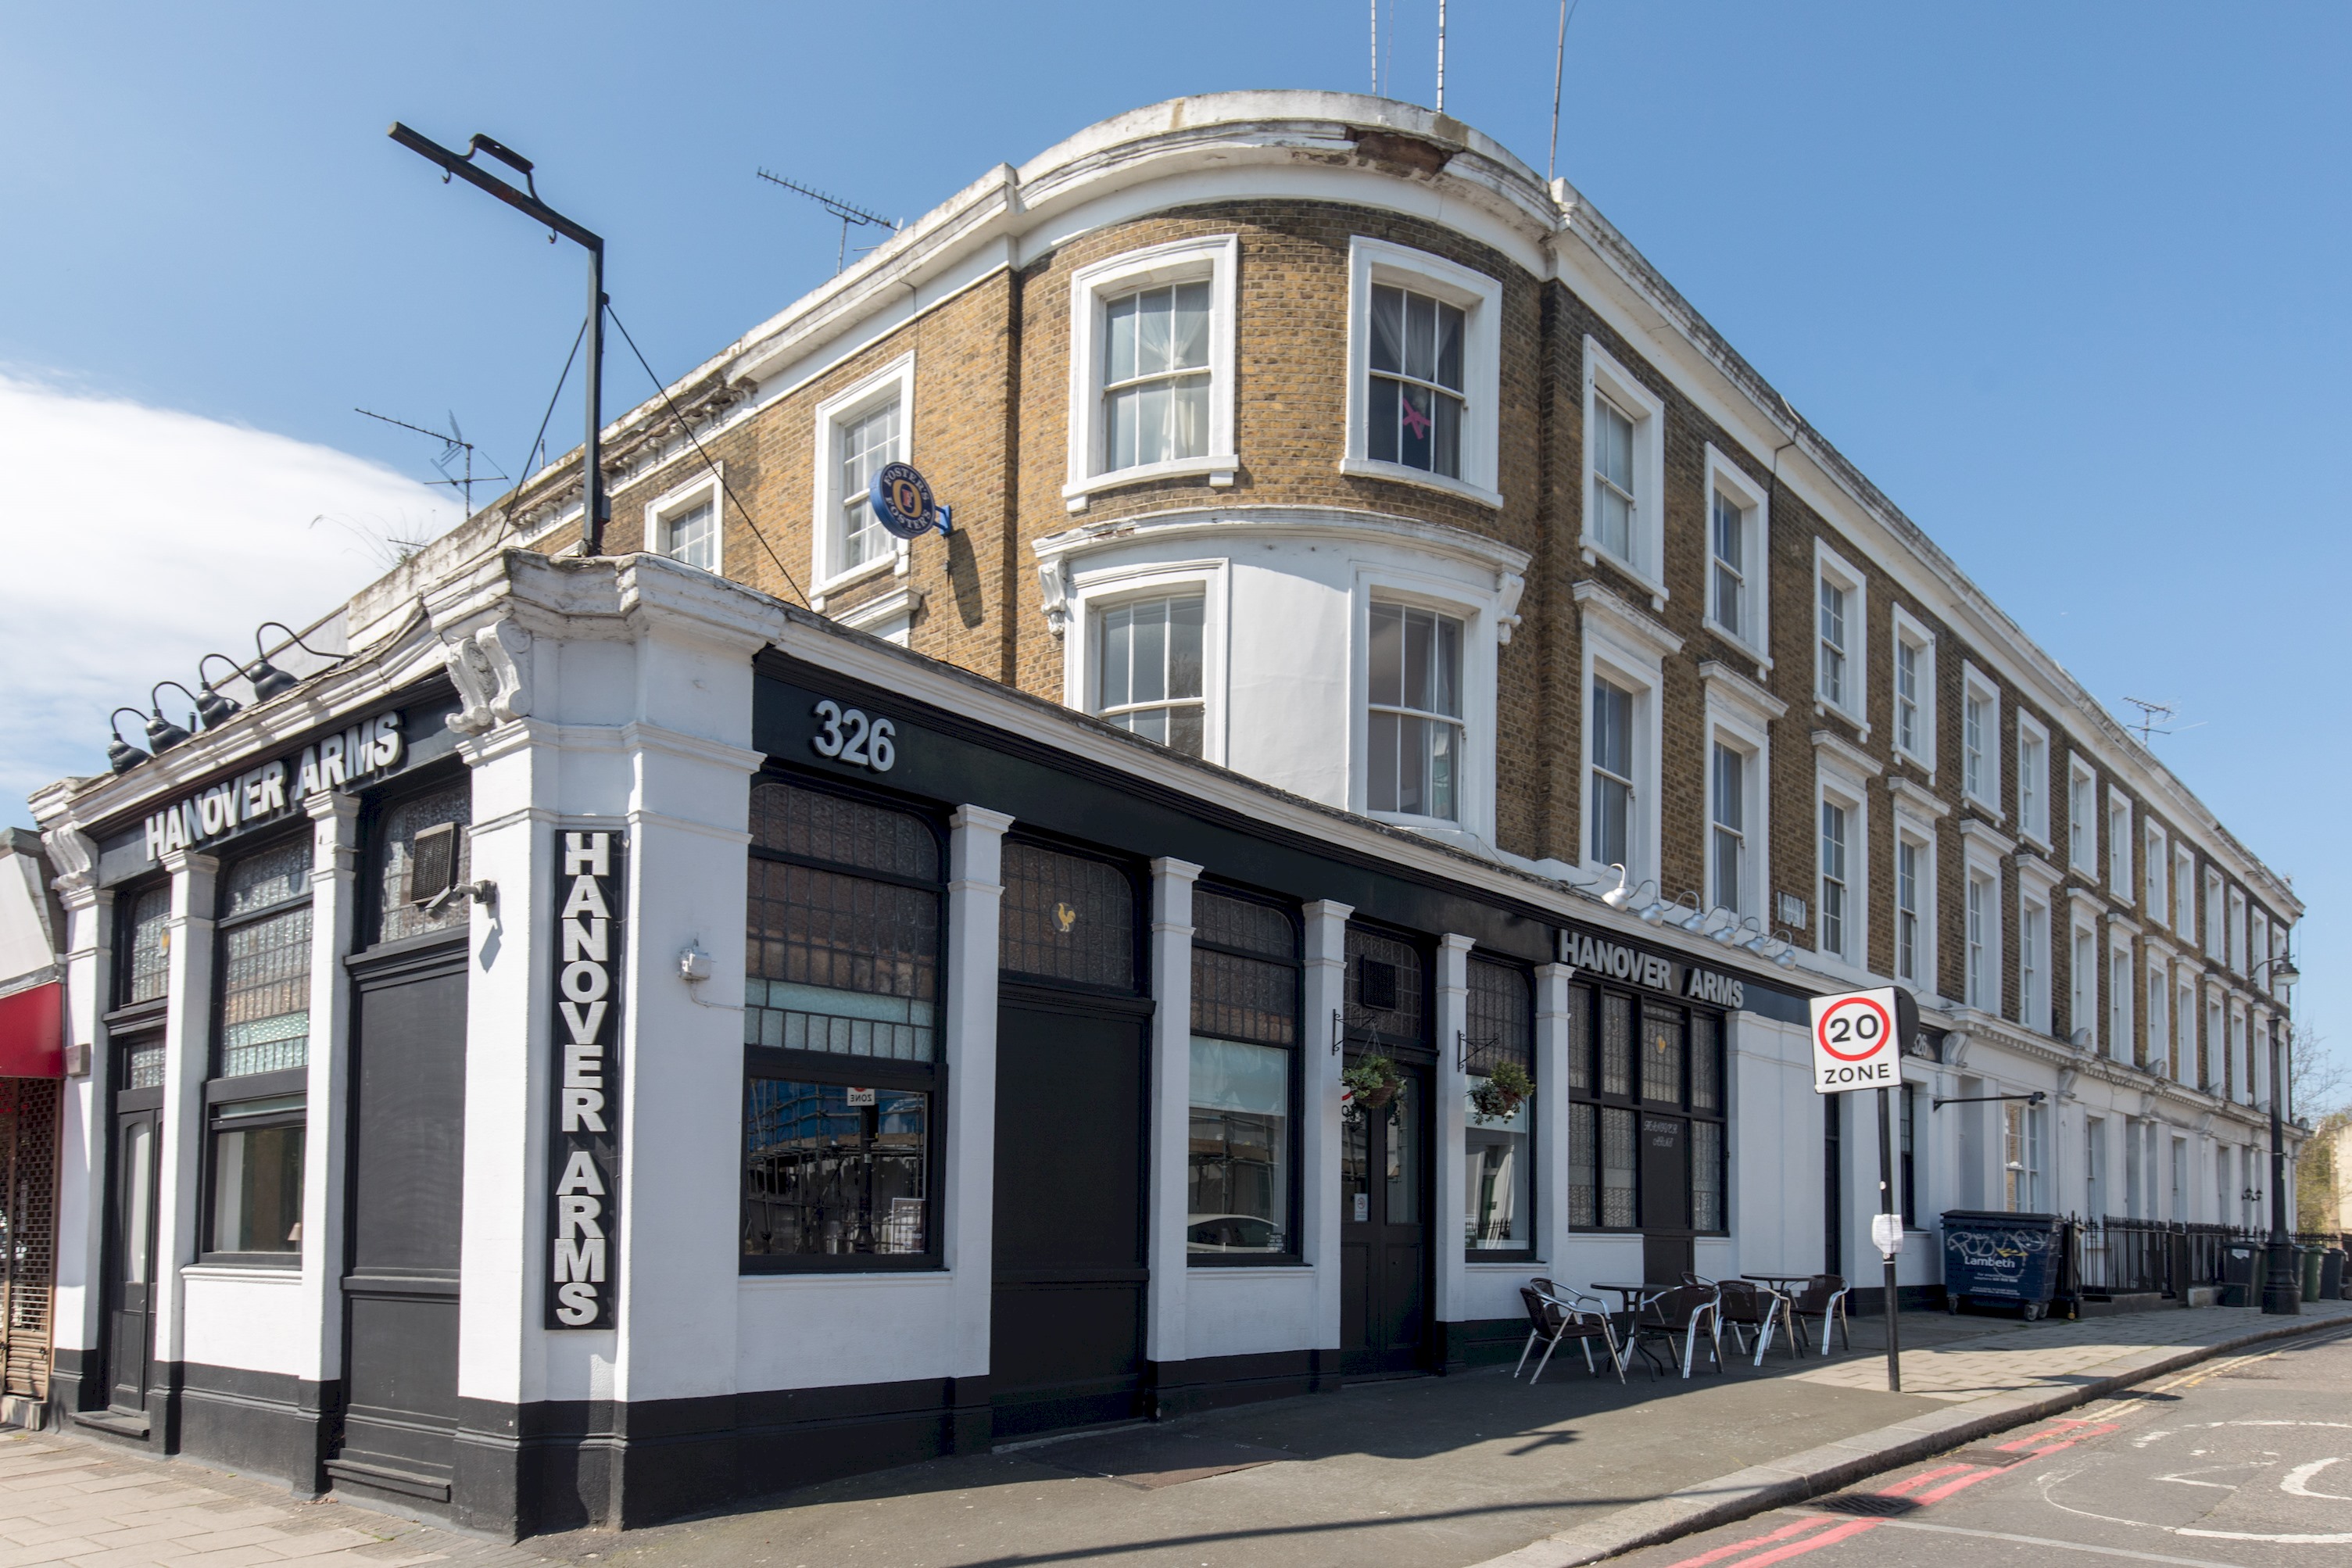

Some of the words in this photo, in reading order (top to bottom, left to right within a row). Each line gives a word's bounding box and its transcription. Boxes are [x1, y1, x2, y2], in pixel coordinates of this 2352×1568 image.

[814, 700, 896, 771] 326
[145, 760, 288, 861] HANOVER
[295, 711, 403, 801] ARMS
[560, 832, 612, 1133] HANOVER
[1559, 929, 1673, 991] HANOVER
[1688, 967, 1745, 1009] ARMS
[1830, 1014, 1879, 1044] 20
[1824, 1063, 1891, 1085] ZONE
[553, 1151, 606, 1327] ARMS
[1964, 1255, 2016, 1268] Lambeth
